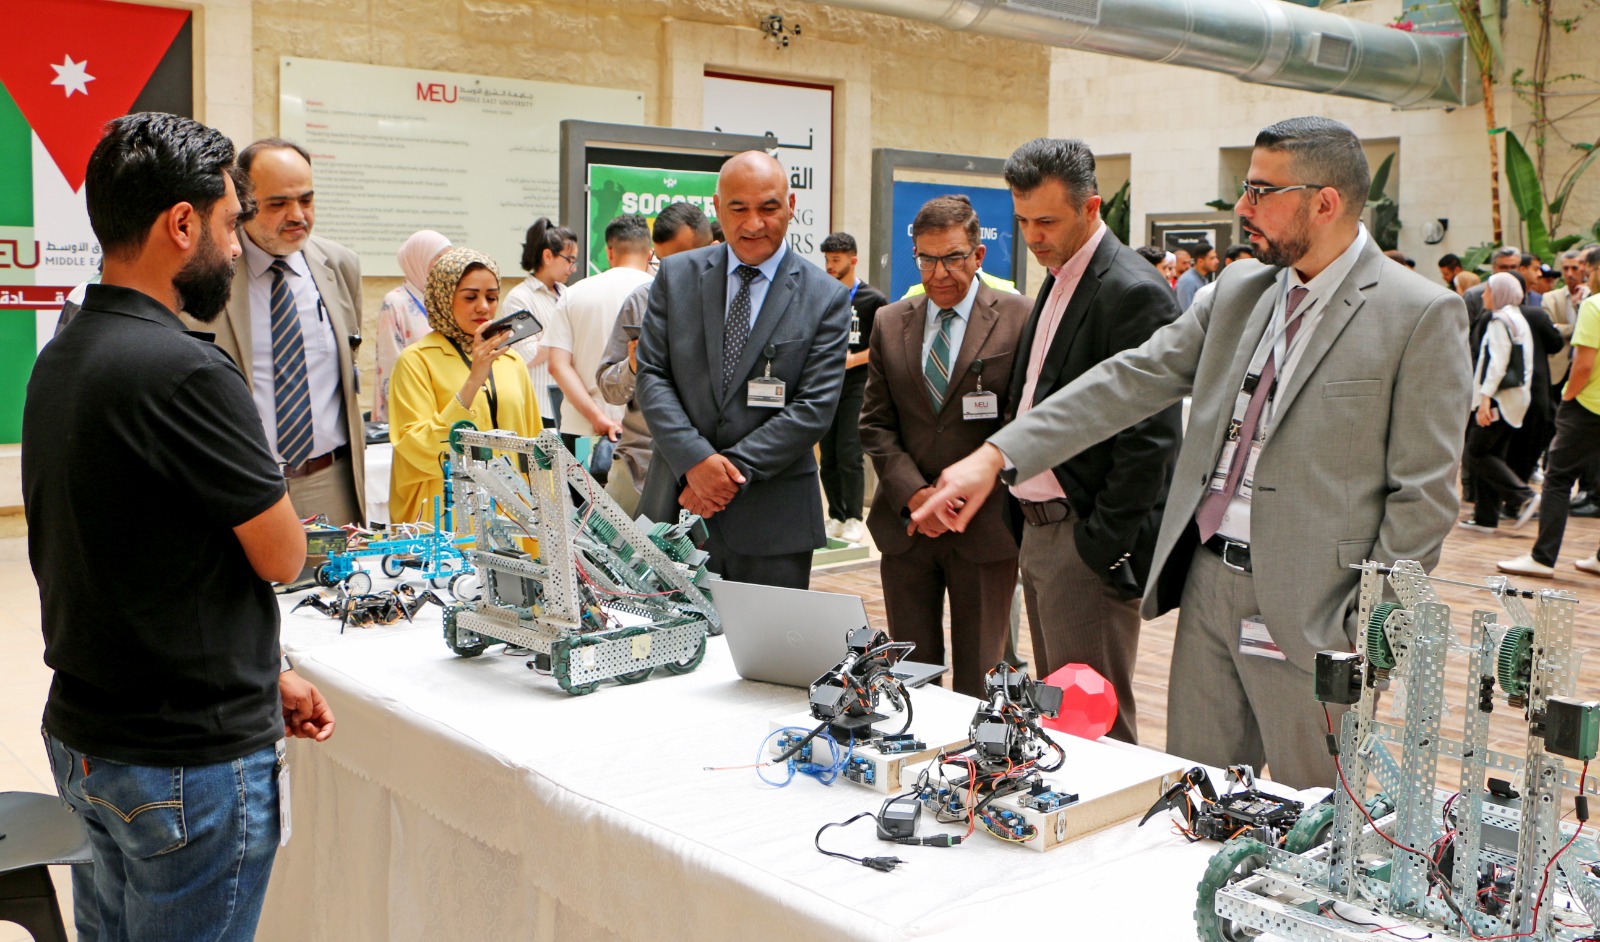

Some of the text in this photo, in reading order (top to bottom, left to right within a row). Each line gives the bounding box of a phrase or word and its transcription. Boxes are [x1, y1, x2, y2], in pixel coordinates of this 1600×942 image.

[416, 82, 457, 103] MEU
[499, 99, 533, 107] UNIVERSITY
[0, 238, 40, 270] EU
[45, 256, 86, 266] MIDDLE
